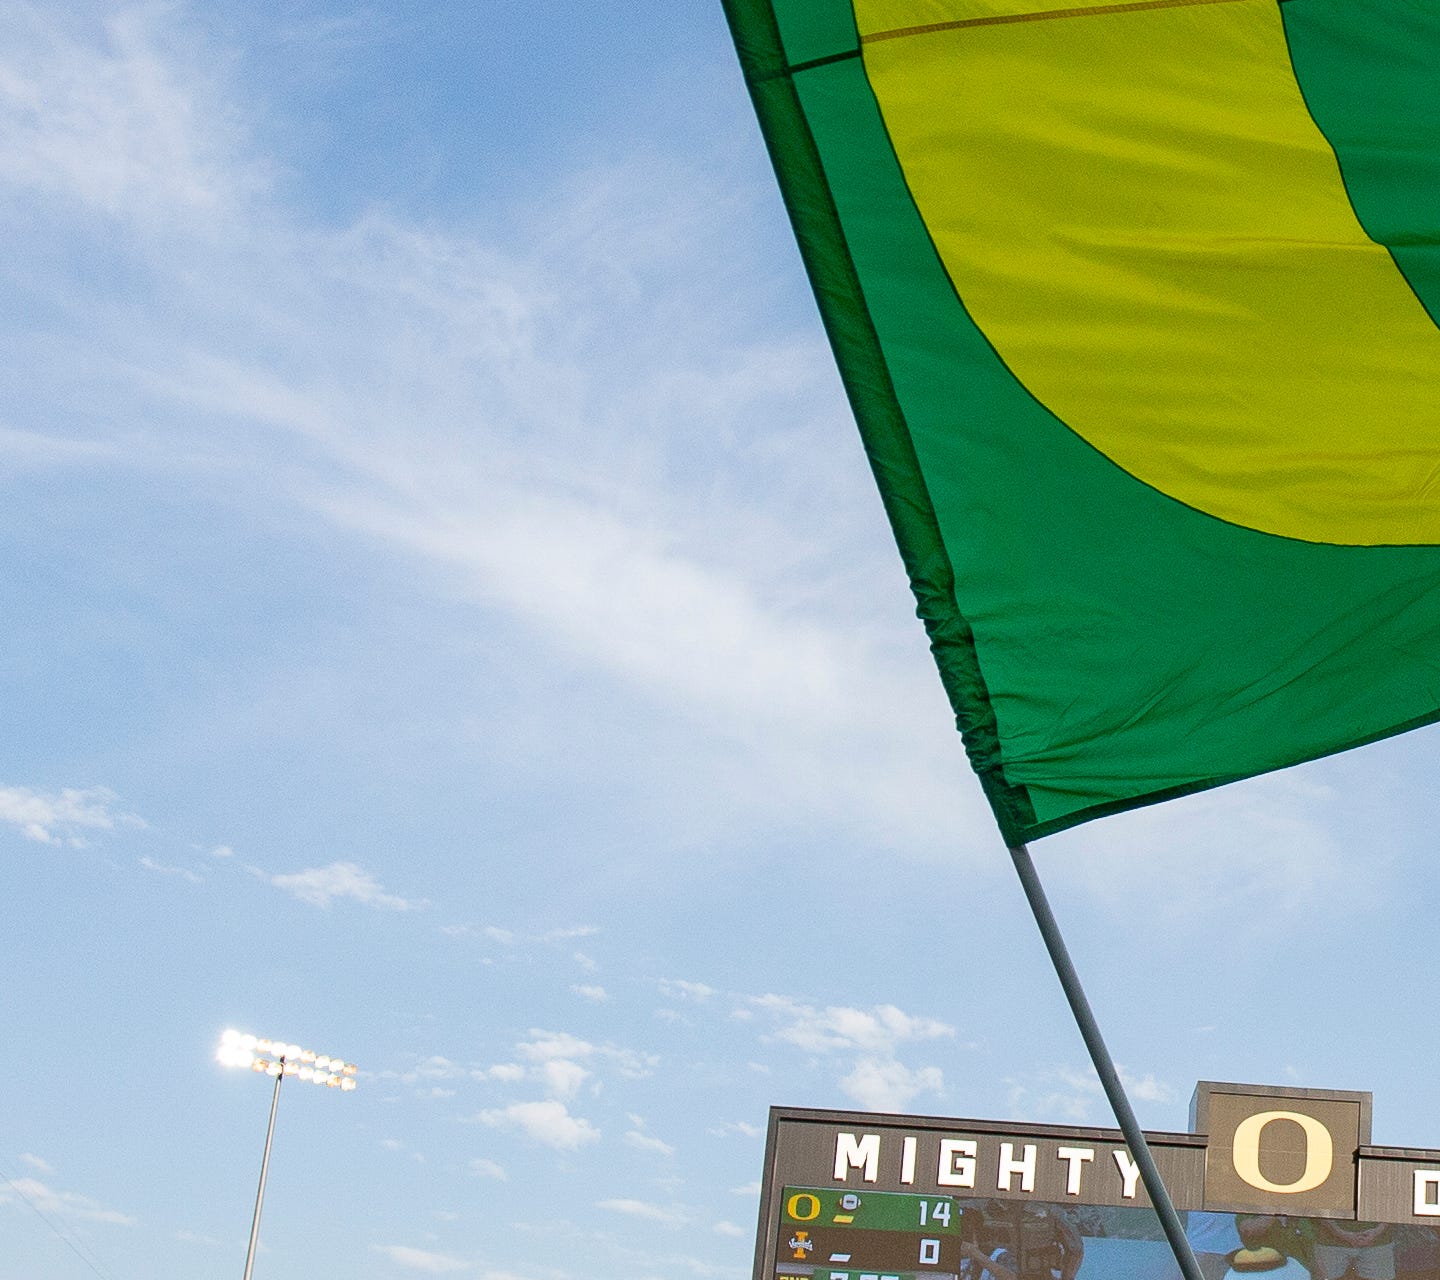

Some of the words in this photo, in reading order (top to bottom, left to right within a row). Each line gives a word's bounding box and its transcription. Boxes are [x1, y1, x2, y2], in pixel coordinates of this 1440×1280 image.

[833, 1132, 1142, 1200] MIGHTY
[1233, 1111, 1333, 1193] O
[786, 1193, 821, 1221] O
[919, 1200, 951, 1228] 14
[919, 1238, 941, 1265] 0
